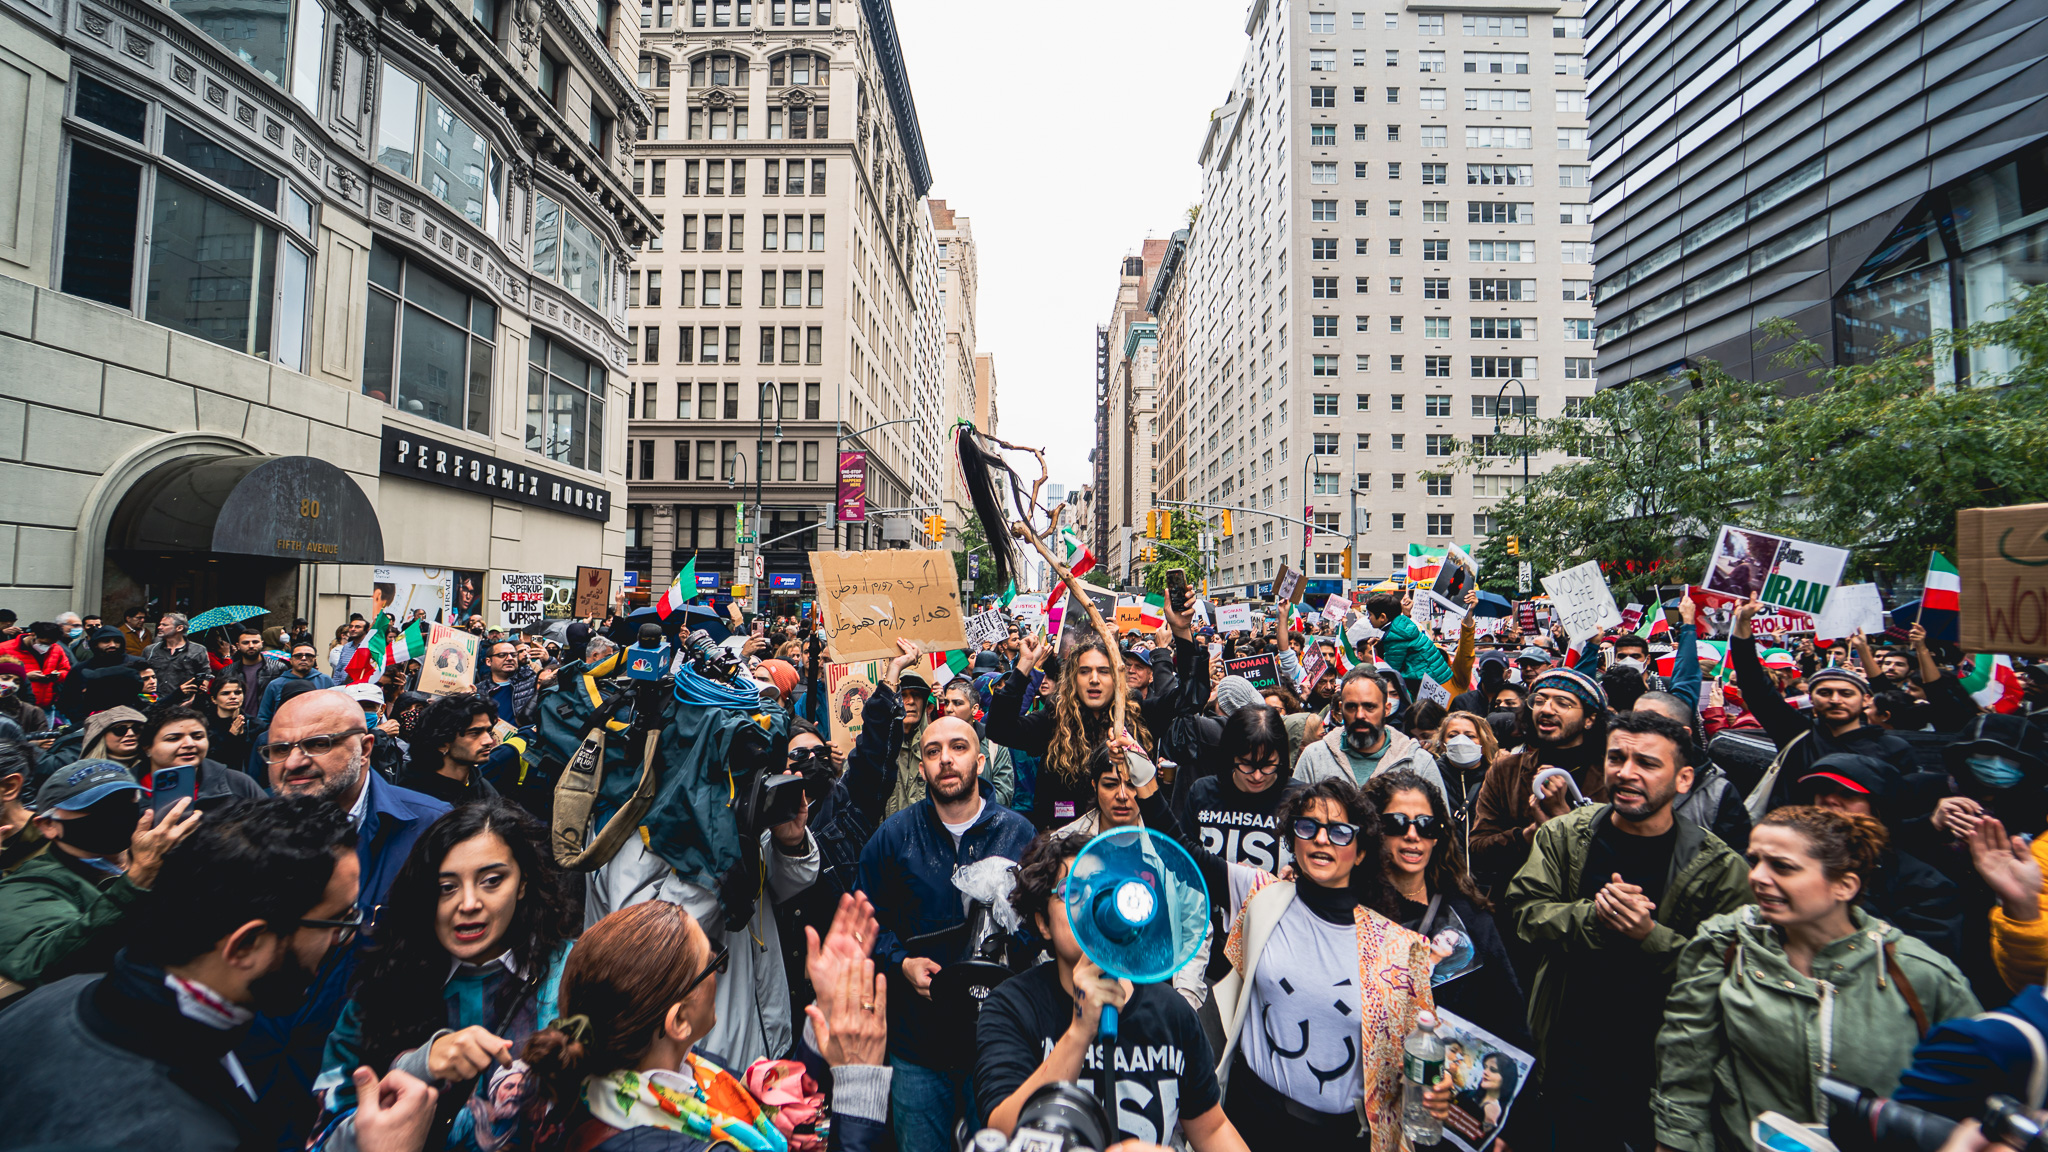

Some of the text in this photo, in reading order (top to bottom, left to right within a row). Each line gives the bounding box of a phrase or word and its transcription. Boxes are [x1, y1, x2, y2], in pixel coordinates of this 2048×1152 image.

[398, 439, 603, 512] PERFORMIX HOUSE
[300, 498, 320, 519] 80
[277, 540, 339, 555] FIFTH AVENUE
[1520, 574, 1530, 582] 25
[1546, 565, 1600, 596] WOMAN
[1568, 585, 1595, 607] LIFE
[1761, 572, 1831, 615] IRAN
[1562, 600, 1615, 634] FREEDOM
[1750, 614, 1815, 634] EVOLUTIO
[1229, 656, 1269, 670] WOMAN
[1243, 669, 1261, 679] LIFE
[848, 724, 863, 732] WOM
[1198, 810, 1280, 829] #MAHSAA
